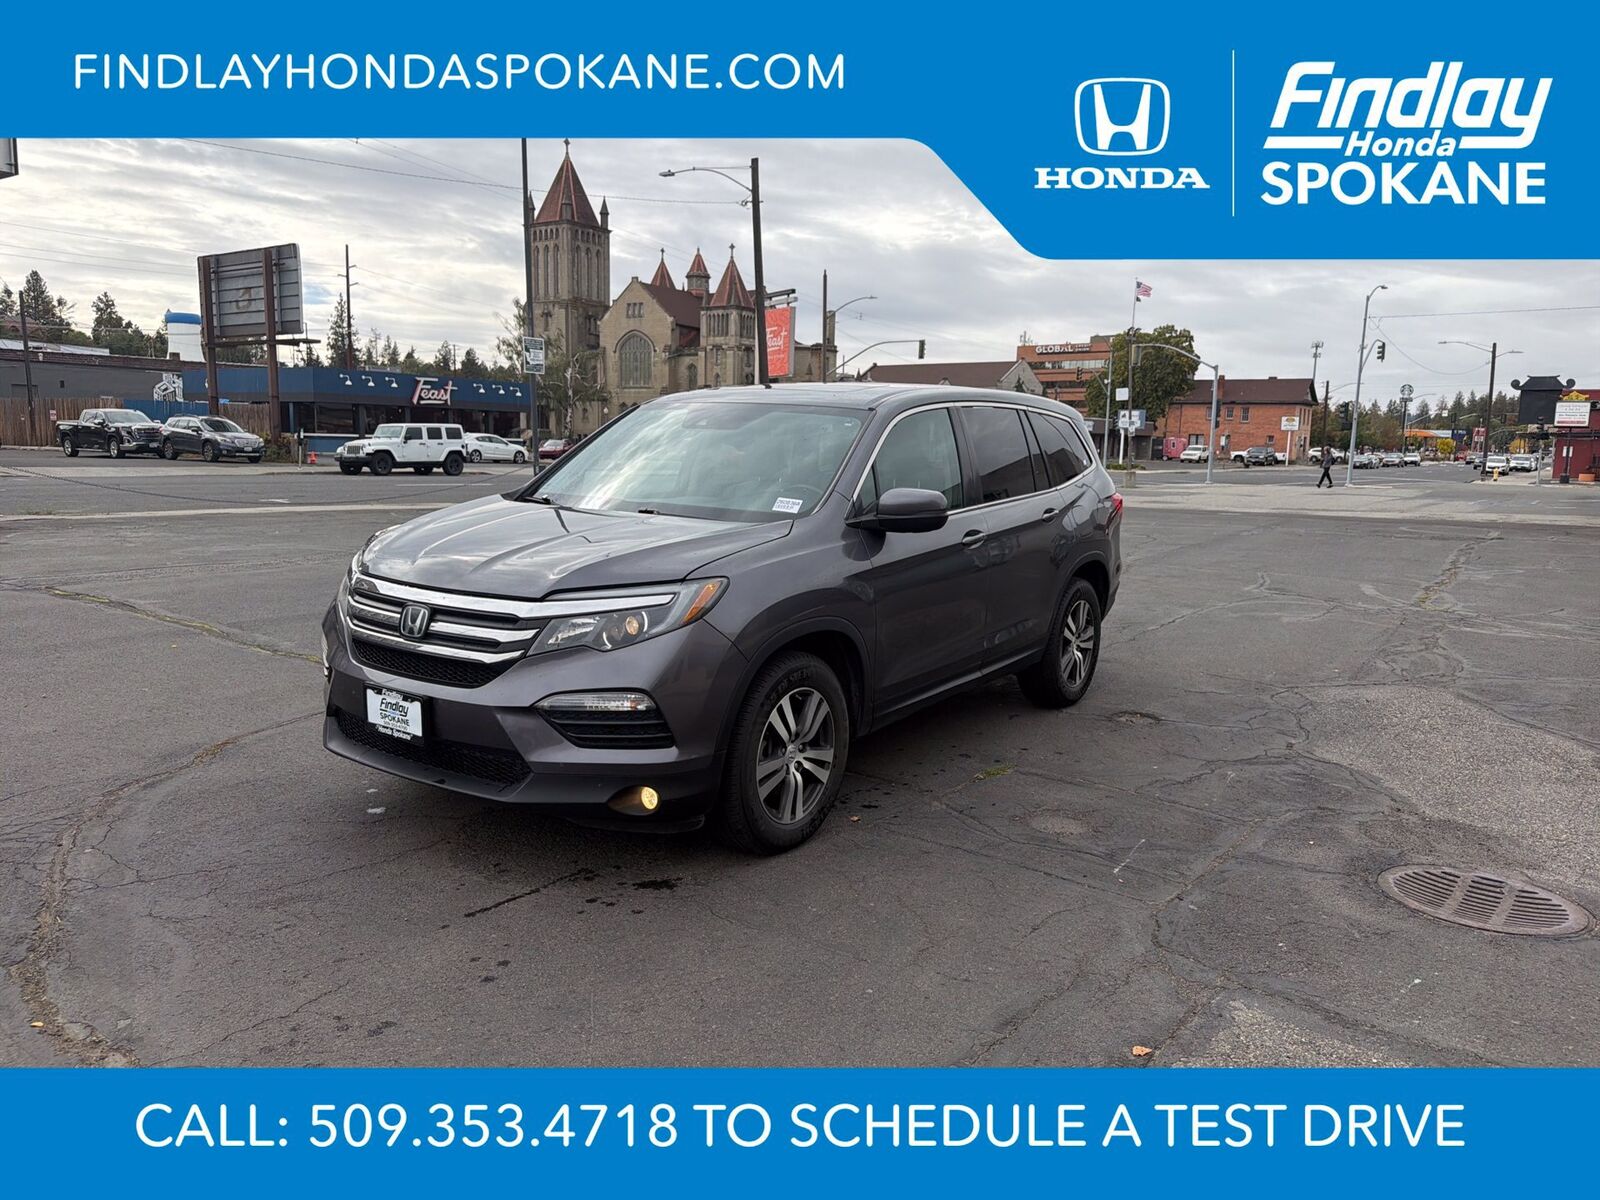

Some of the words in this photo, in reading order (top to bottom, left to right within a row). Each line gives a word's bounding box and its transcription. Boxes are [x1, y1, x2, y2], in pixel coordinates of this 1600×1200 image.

[1035, 344, 1074, 353] GLOBAL
[412, 376, 458, 406] Feast
[380, 698, 409, 717] Findlay
[380, 712, 410, 726] SPOKANE
